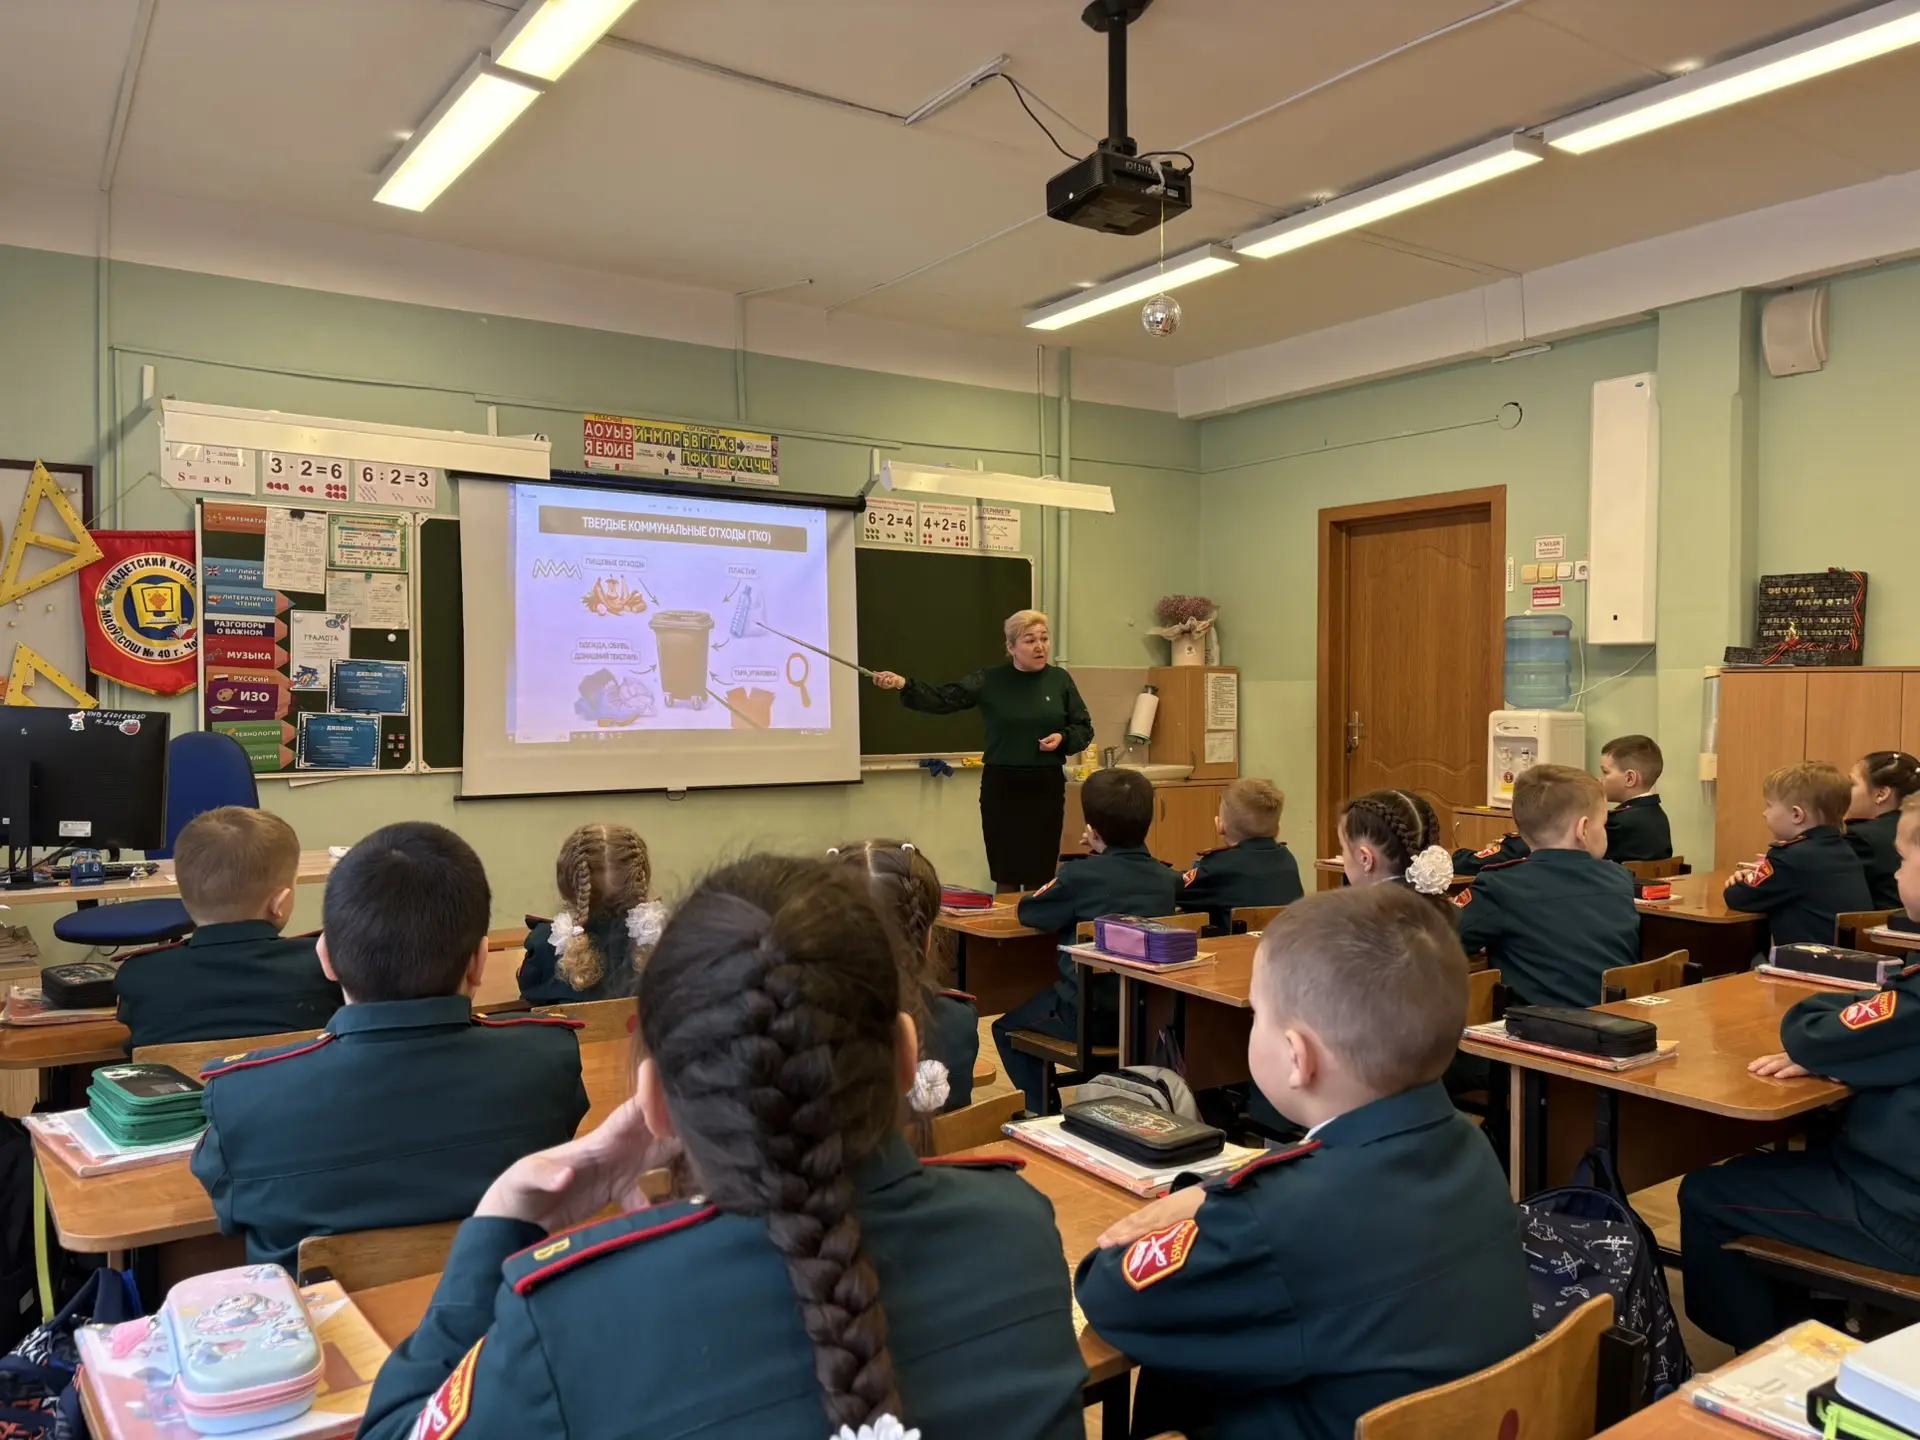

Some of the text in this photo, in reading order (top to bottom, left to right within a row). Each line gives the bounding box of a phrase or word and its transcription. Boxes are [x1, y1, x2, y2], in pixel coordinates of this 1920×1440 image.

[270, 458, 282, 473] 3
[177, 471, 186, 481] S
[203, 475, 210, 483] a
[224, 475, 232, 485] b
[362, 467, 373, 482] 6
[868, 512, 876, 525] 6
[923, 517, 931, 529] 4
[581, 516, 771, 544] ТВЕРДЫЕ КОММУНАЛЬНЫЕ ОТХОДЫ (ТКО)
[585, 557, 645, 568] ПИЩЕВЫЕ ОТХОДЫ
[106, 556, 197, 590] КАДЕТСКИЙ КЛАС
[728, 566, 757, 575] ПЛАСТИК
[222, 594, 274, 602] ЛИТЕРАТУРНОЕ
[1796, 596, 1854, 606] ПАМЯТЬ!
[214, 620, 266, 629] РАЗГОВОРЫ
[101, 609, 120, 636] МАОУ
[117, 633, 142, 654] СОШ
[142, 647, 155, 657] №
[158, 649, 171, 659] 40
[225, 628, 263, 636] ВАЖНОМ
[226, 650, 272, 661] МУЗЫКА
[573, 651, 609, 660] ДОМАШНИЙ
[233, 674, 269, 683] РУССКИЙ
[240, 690, 270, 702] ИЗО
[235, 729, 281, 737] ТЕХНОЛОГИЯ
